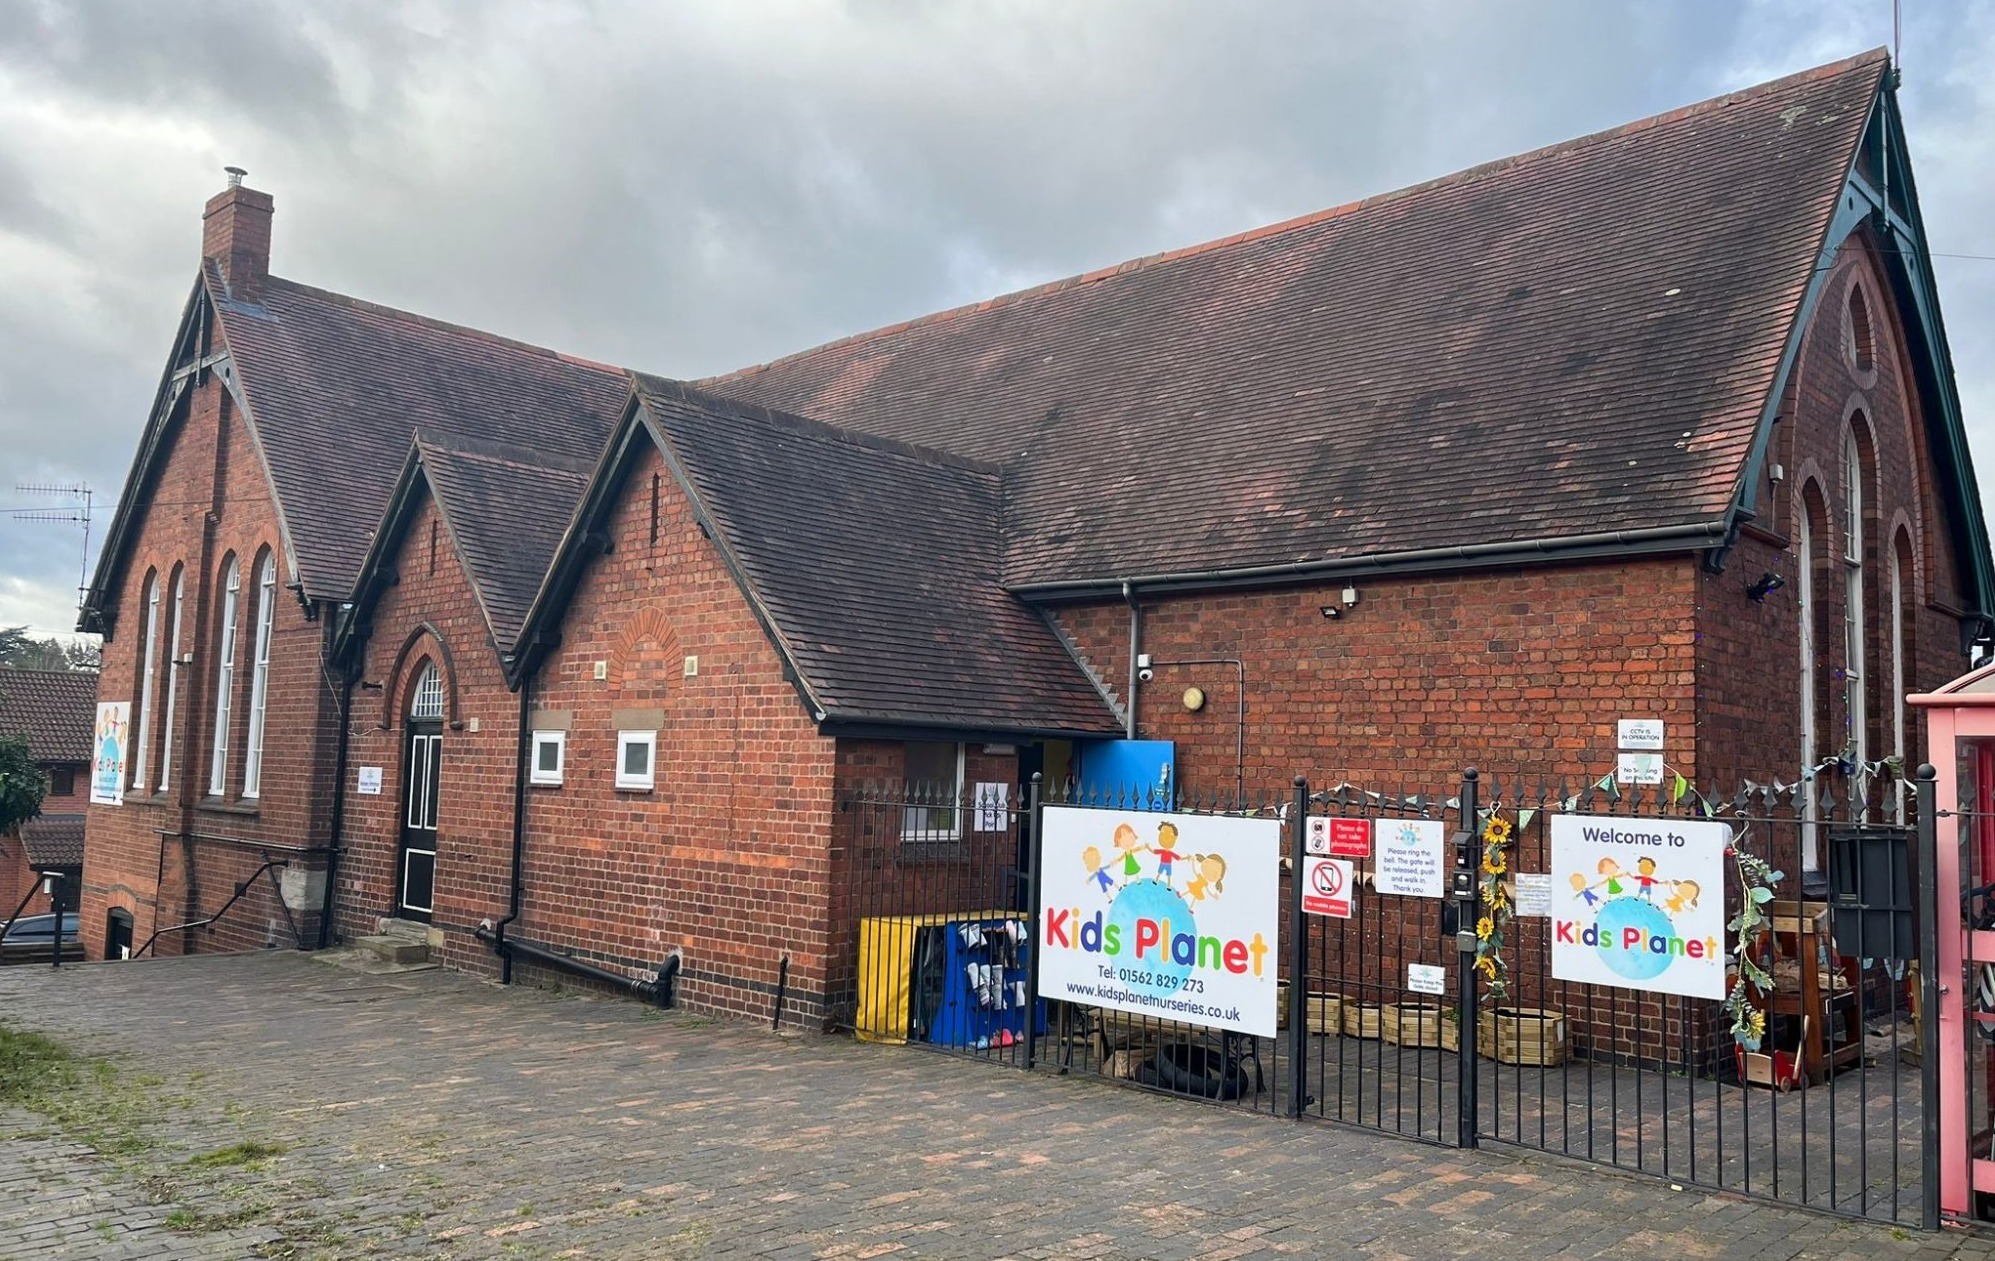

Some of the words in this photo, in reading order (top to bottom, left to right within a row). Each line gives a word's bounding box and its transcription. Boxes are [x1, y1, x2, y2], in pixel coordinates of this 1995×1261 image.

[1387, 847, 1406, 855] Please
[1408, 848, 1420, 857] ring
[1583, 826, 1662, 846] Welcome
[1668, 832, 1685, 847] to
[1046, 907, 1121, 955] Kids
[1135, 917, 1269, 977] Planet
[1556, 920, 1612, 948] Kids
[1623, 926, 1717, 960] Planet
[1098, 965, 1116, 980] Tel:
[1119, 968, 1152, 986] 01562
[1156, 973, 1179, 989] 829
[1182, 977, 1204, 993] 273
[1067, 983, 1240, 1021] www.kidsplanetnurseries.co.uk
